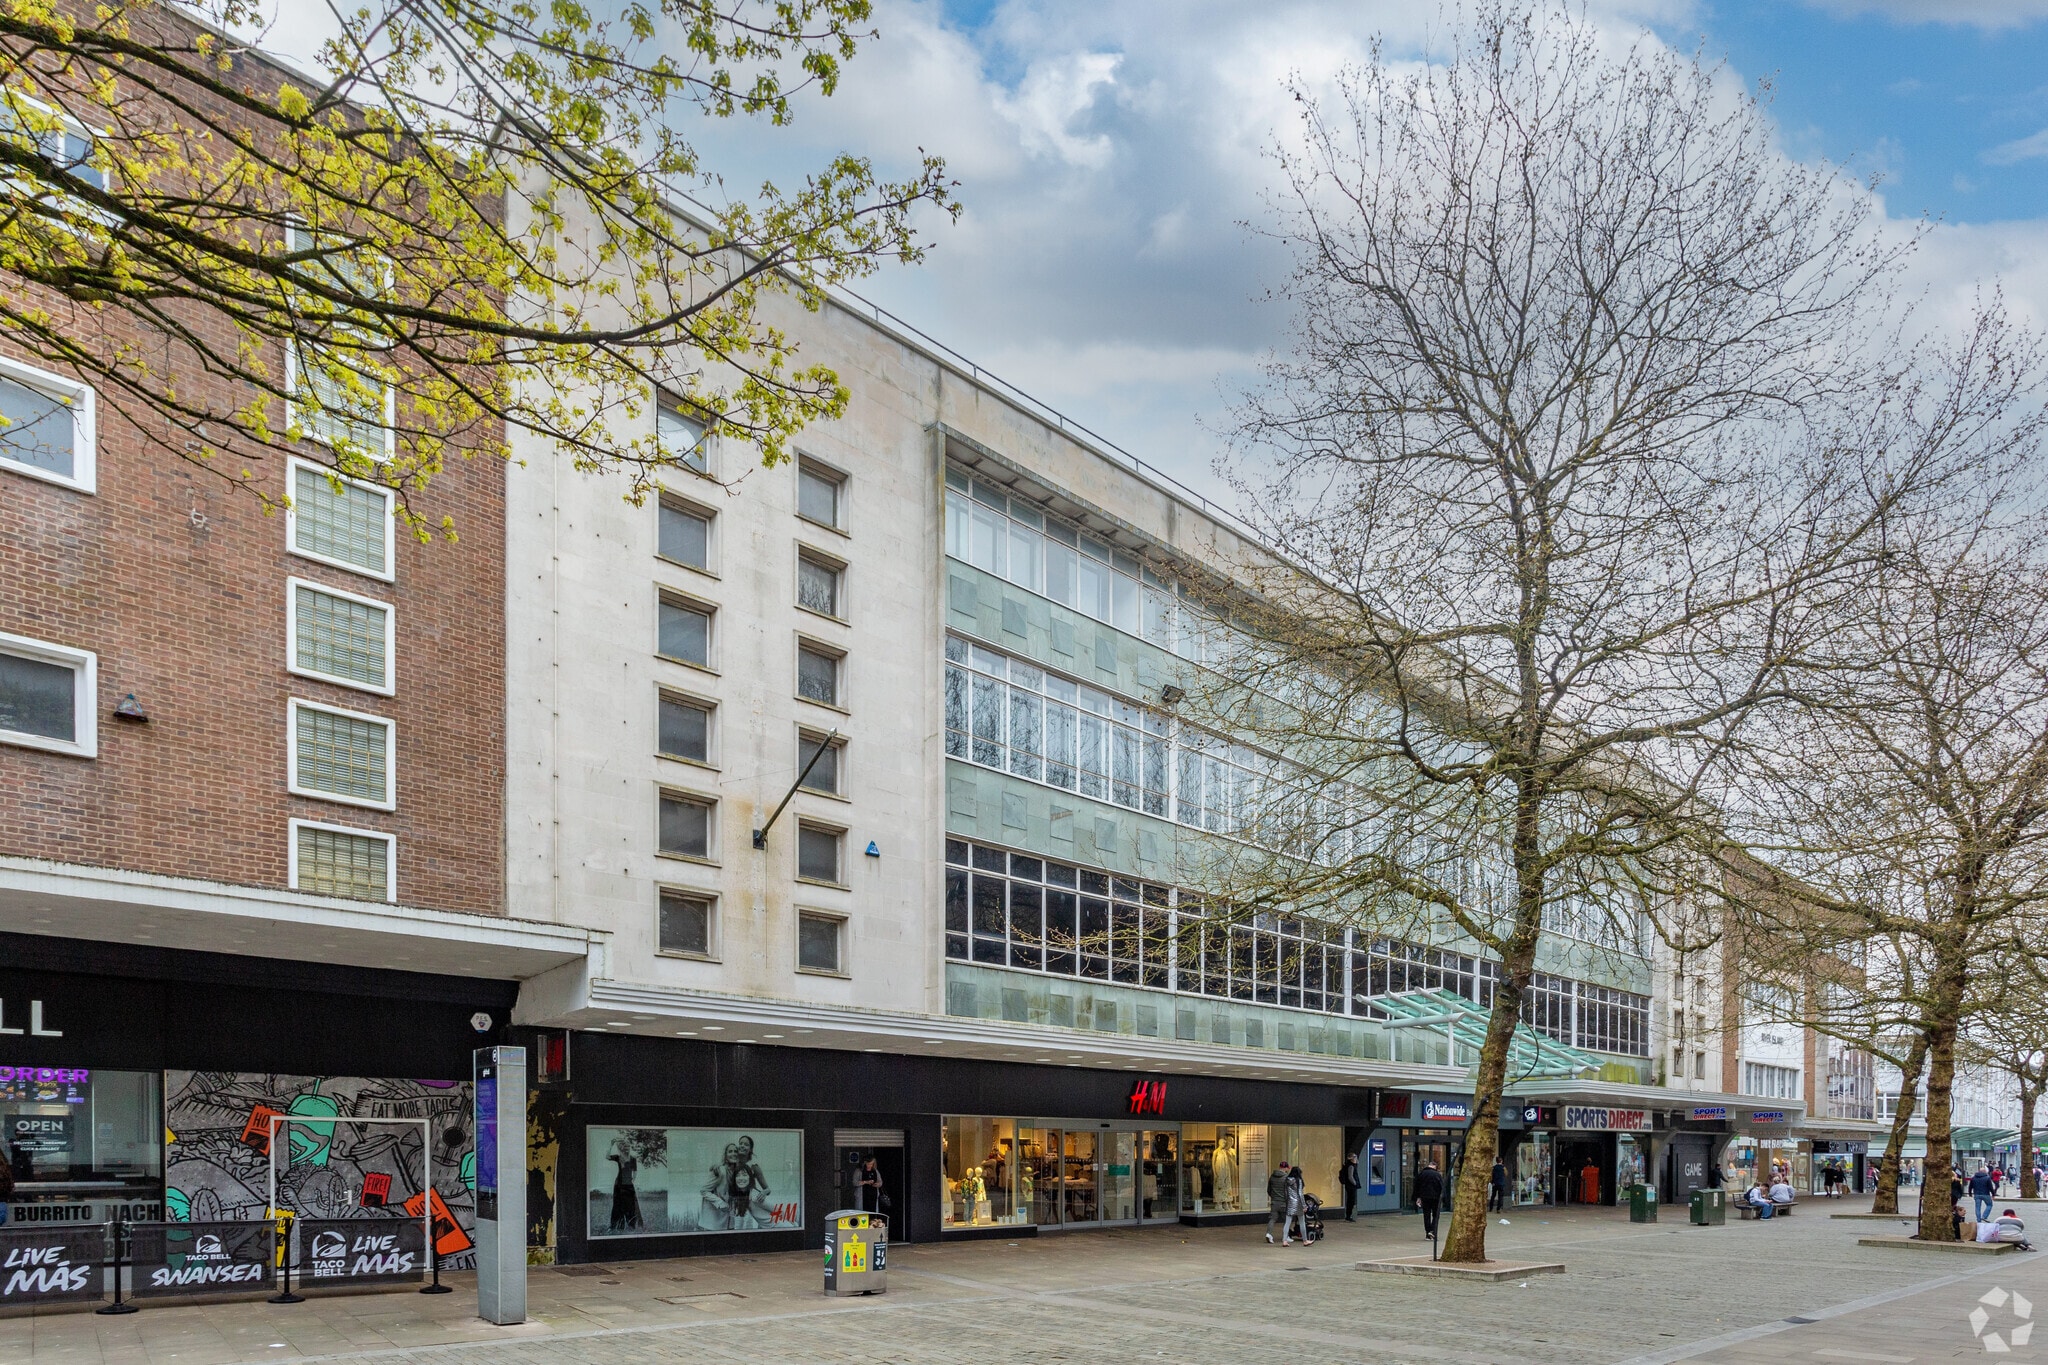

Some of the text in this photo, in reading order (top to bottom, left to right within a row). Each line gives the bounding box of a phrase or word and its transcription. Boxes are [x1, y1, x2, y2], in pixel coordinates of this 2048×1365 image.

[0, 1066, 89, 1083] ORDER
[1130, 1080, 1167, 1115] H&M
[371, 1102, 392, 1118] EAT
[394, 1099, 422, 1118] MORE
[1434, 1104, 1466, 1117] Nationwide
[16, 1120, 64, 1131] OPEN
[252, 1112, 272, 1129] HO
[1567, 1107, 1608, 1129] SPORTS
[1684, 1163, 1702, 1177] GAME
[367, 1177, 388, 1193] FIRE!
[14, 1205, 93, 1222] BURRITO
[769, 1203, 797, 1224] H&M
[312, 1260, 346, 1269] TACO
[351, 1248, 415, 1276] MÁS
[4, 1260, 91, 1296] MÁS
[150, 1263, 262, 1287] SWANSEA
[314, 1268, 345, 1277] BELL
